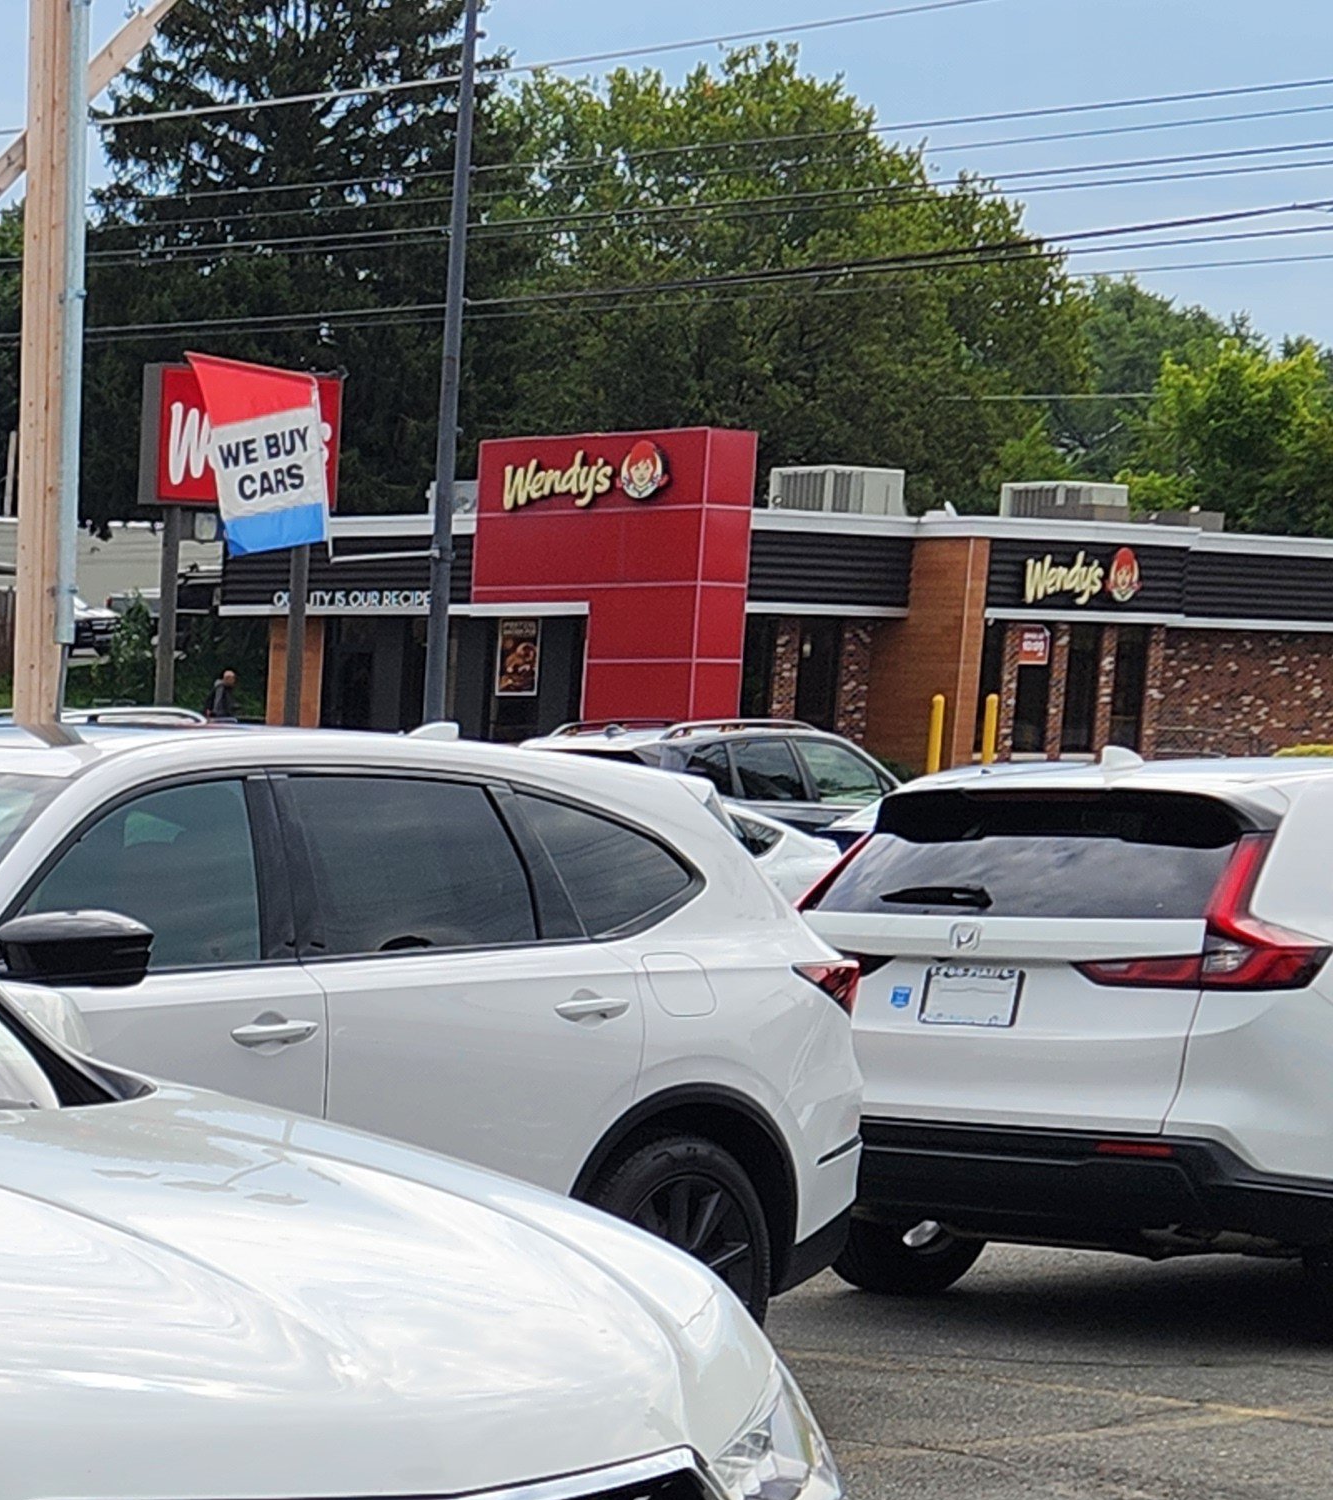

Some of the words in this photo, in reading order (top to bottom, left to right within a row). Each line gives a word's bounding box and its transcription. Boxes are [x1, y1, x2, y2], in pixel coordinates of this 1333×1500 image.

[218, 438, 258, 470] WE
[264, 426, 310, 460] BUY
[238, 463, 305, 501] CARS
[503, 450, 613, 511] Wendy's
[333, 591, 346, 607] IS
[349, 590, 380, 607] OUR
[382, 590, 432, 607] RECIPE
[1024, 550, 1105, 605] Wendy's
